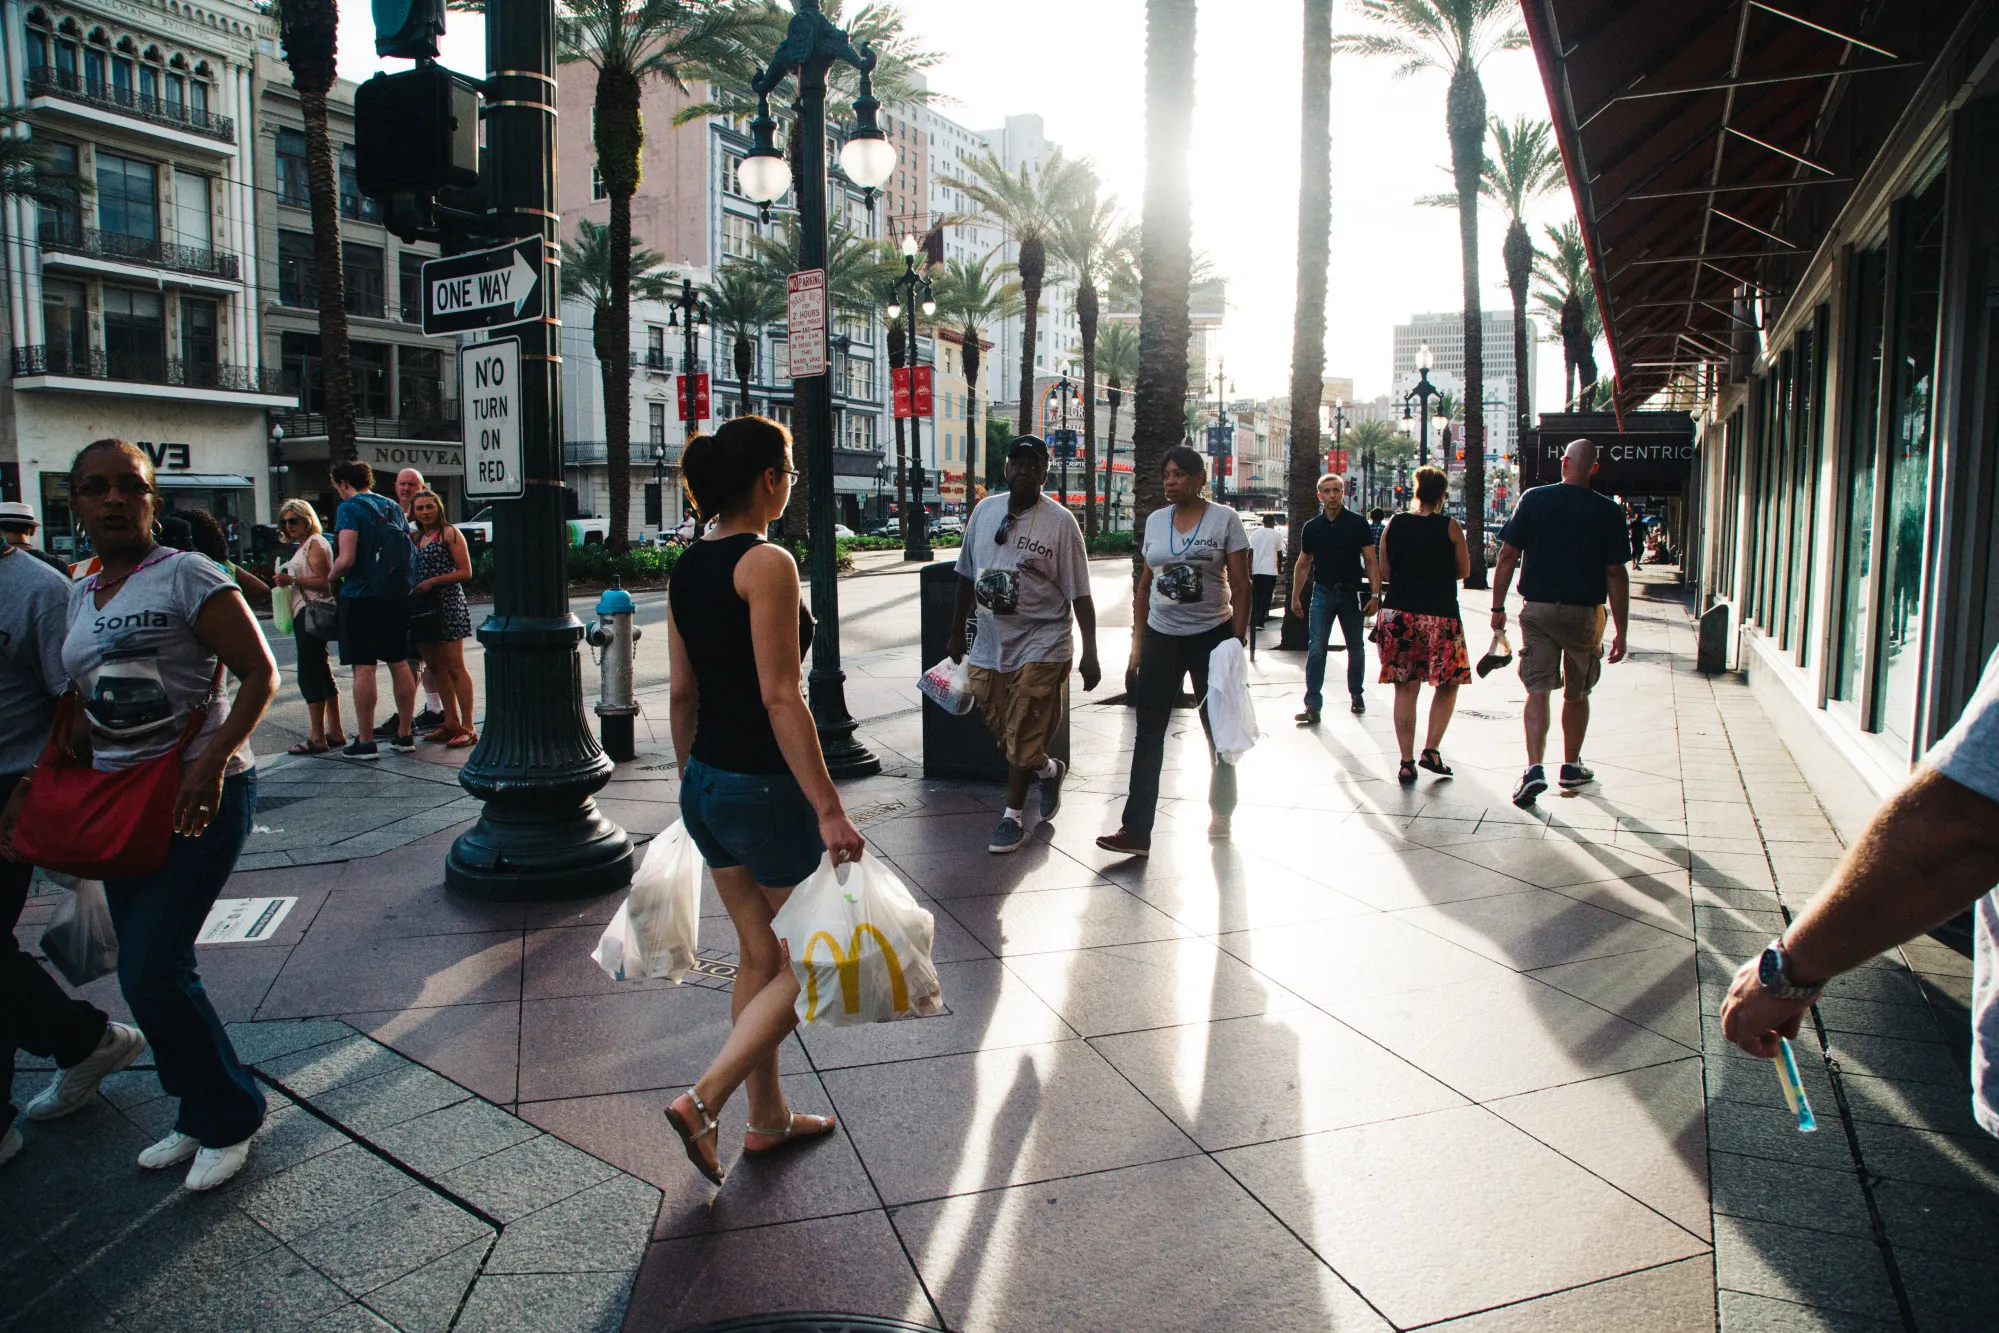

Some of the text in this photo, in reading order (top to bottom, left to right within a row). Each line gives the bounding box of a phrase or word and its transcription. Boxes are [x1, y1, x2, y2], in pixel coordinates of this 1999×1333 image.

[437, 270, 511, 311] ONE WAY
[789, 274, 822, 290] NO PARKING
[800, 308, 820, 319] HOURS
[475, 357, 504, 389] NO
[473, 395, 508, 420] TURN
[481, 428, 500, 451] ON
[1610, 445, 1693, 461] CENTRIC
[479, 460, 504, 482] RED
[1017, 536, 1053, 559] Eldon
[1182, 538, 1218, 548] Wanda
[93, 610, 168, 634] Sonia
